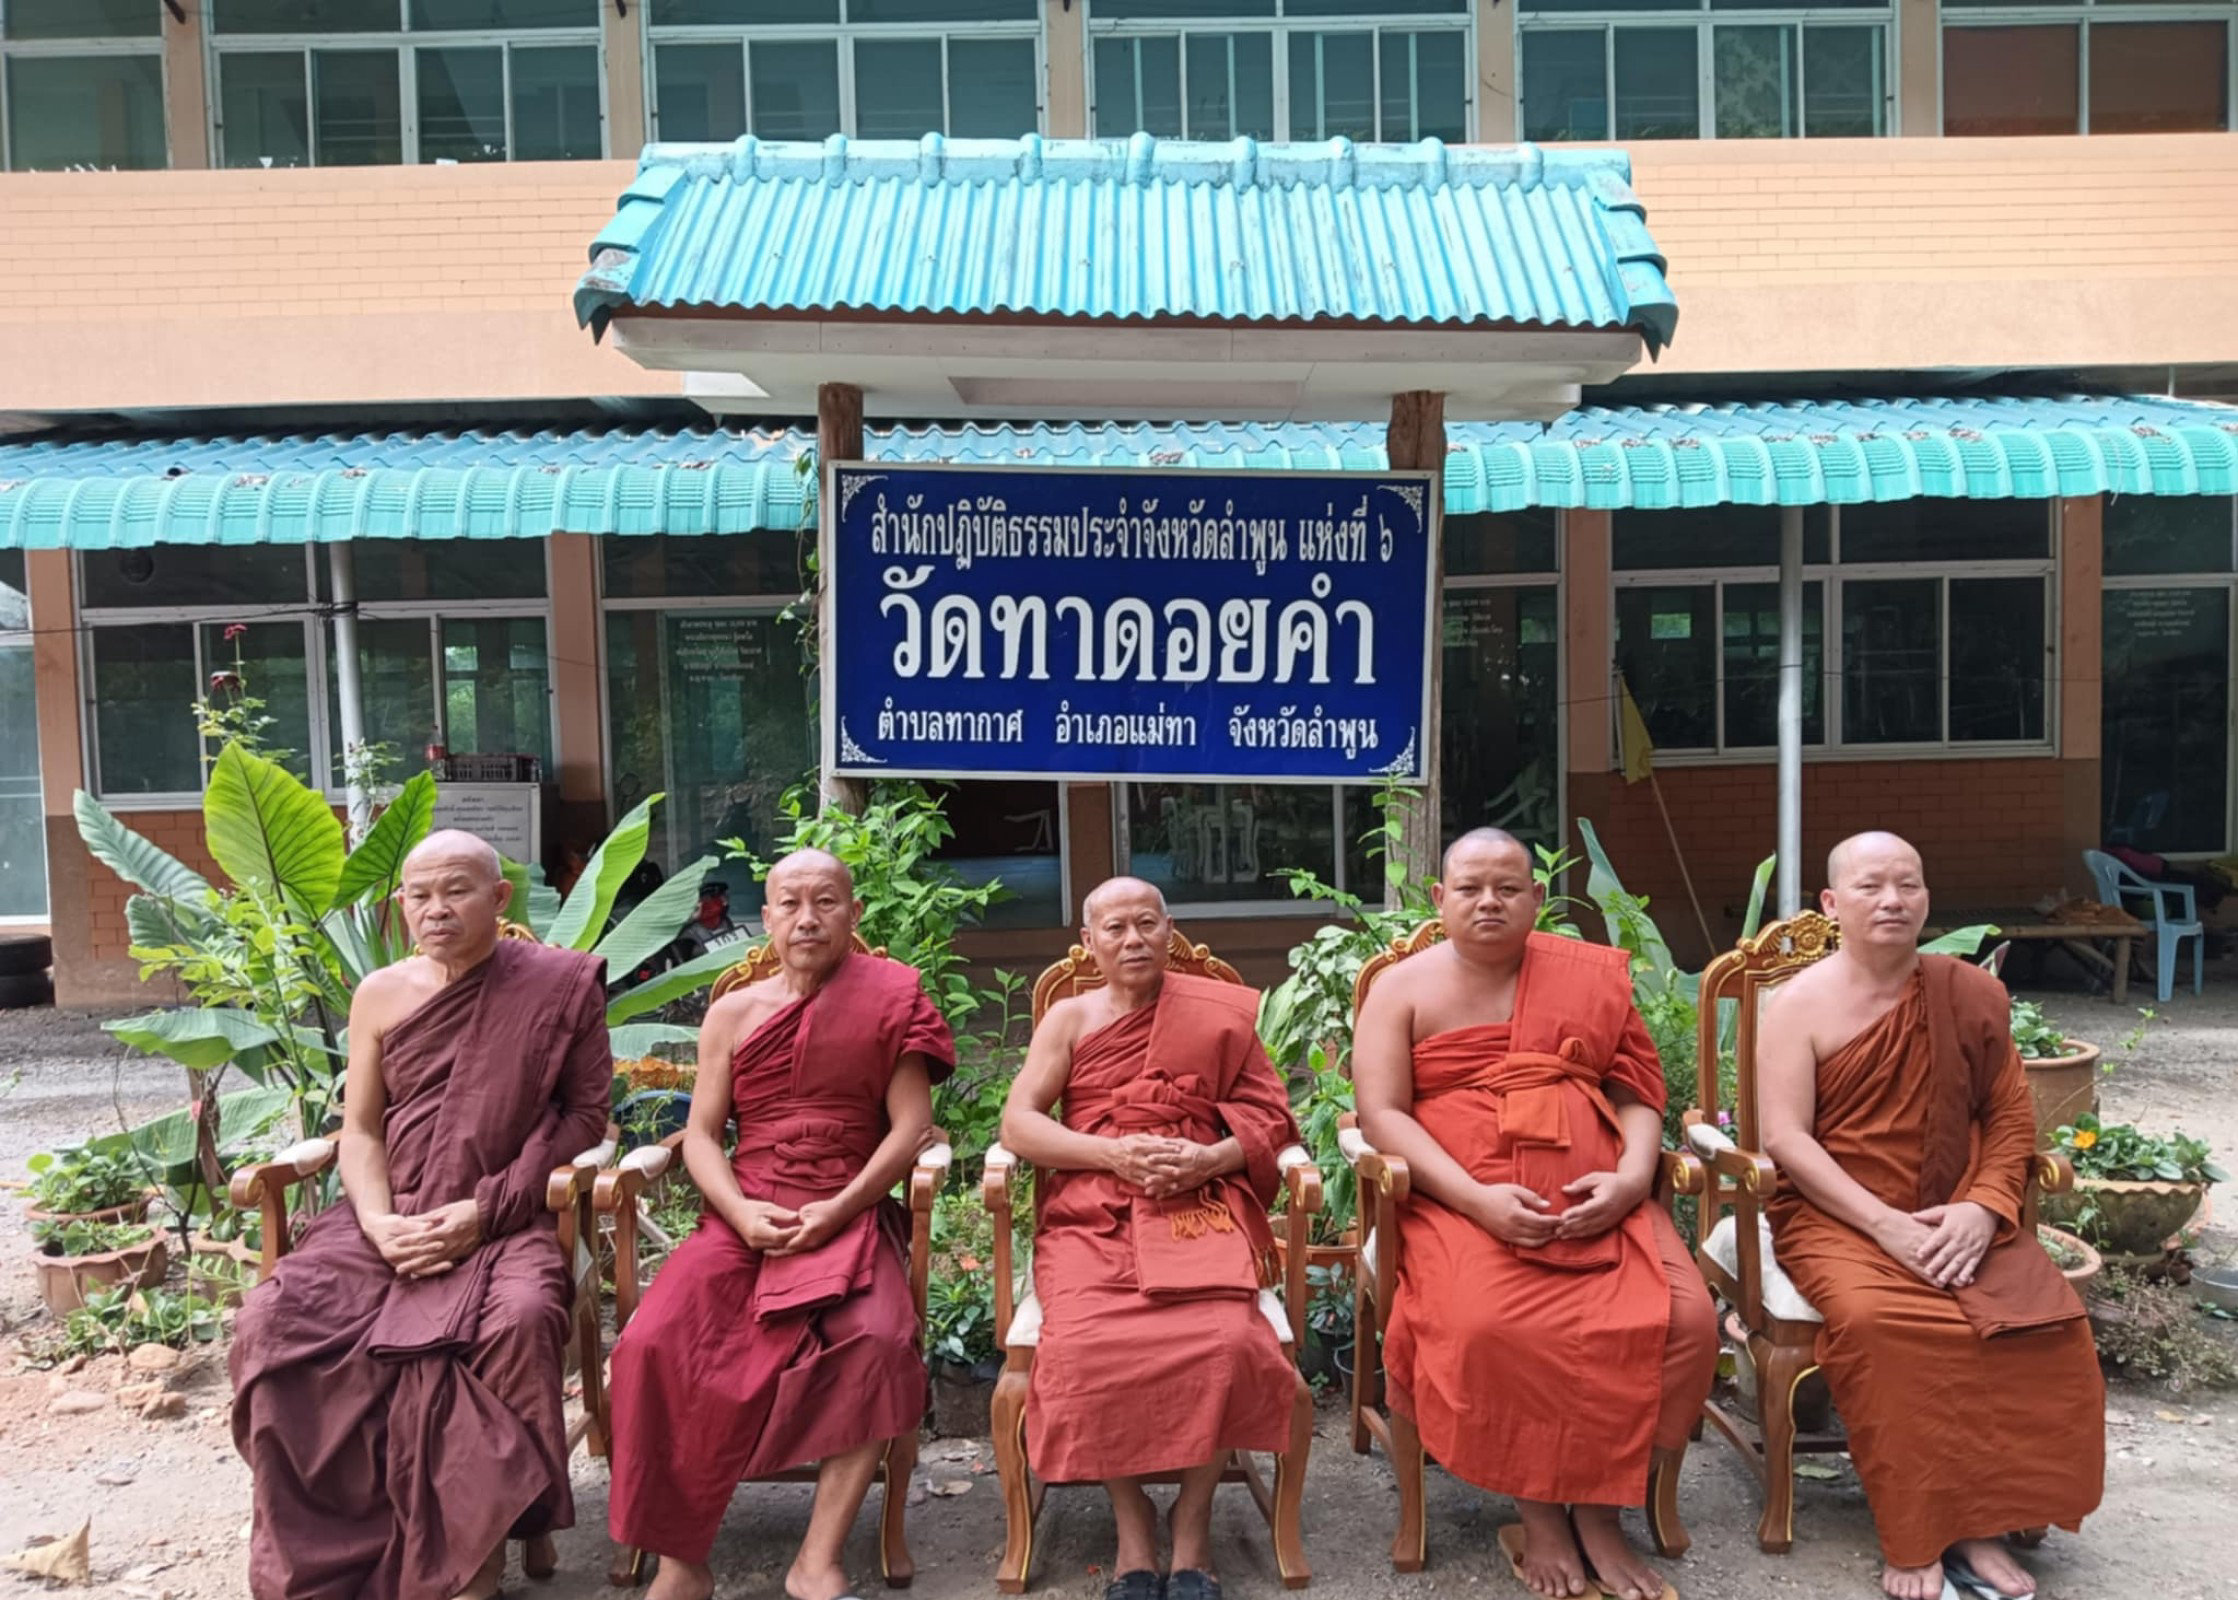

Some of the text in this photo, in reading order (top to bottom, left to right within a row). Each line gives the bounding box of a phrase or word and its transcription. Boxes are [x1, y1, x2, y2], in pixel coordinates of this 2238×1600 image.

[872, 493, 1394, 575] สำนักปฏิบัติธรรมประจำจังหวัดลำพูน แห่งที่ ๖
[880, 565, 1377, 684] วัดทาดอยคำ
[878, 696, 1379, 760] ตำบลทากาศ อำเภอแม่ทา จังหวัดลำพูน
